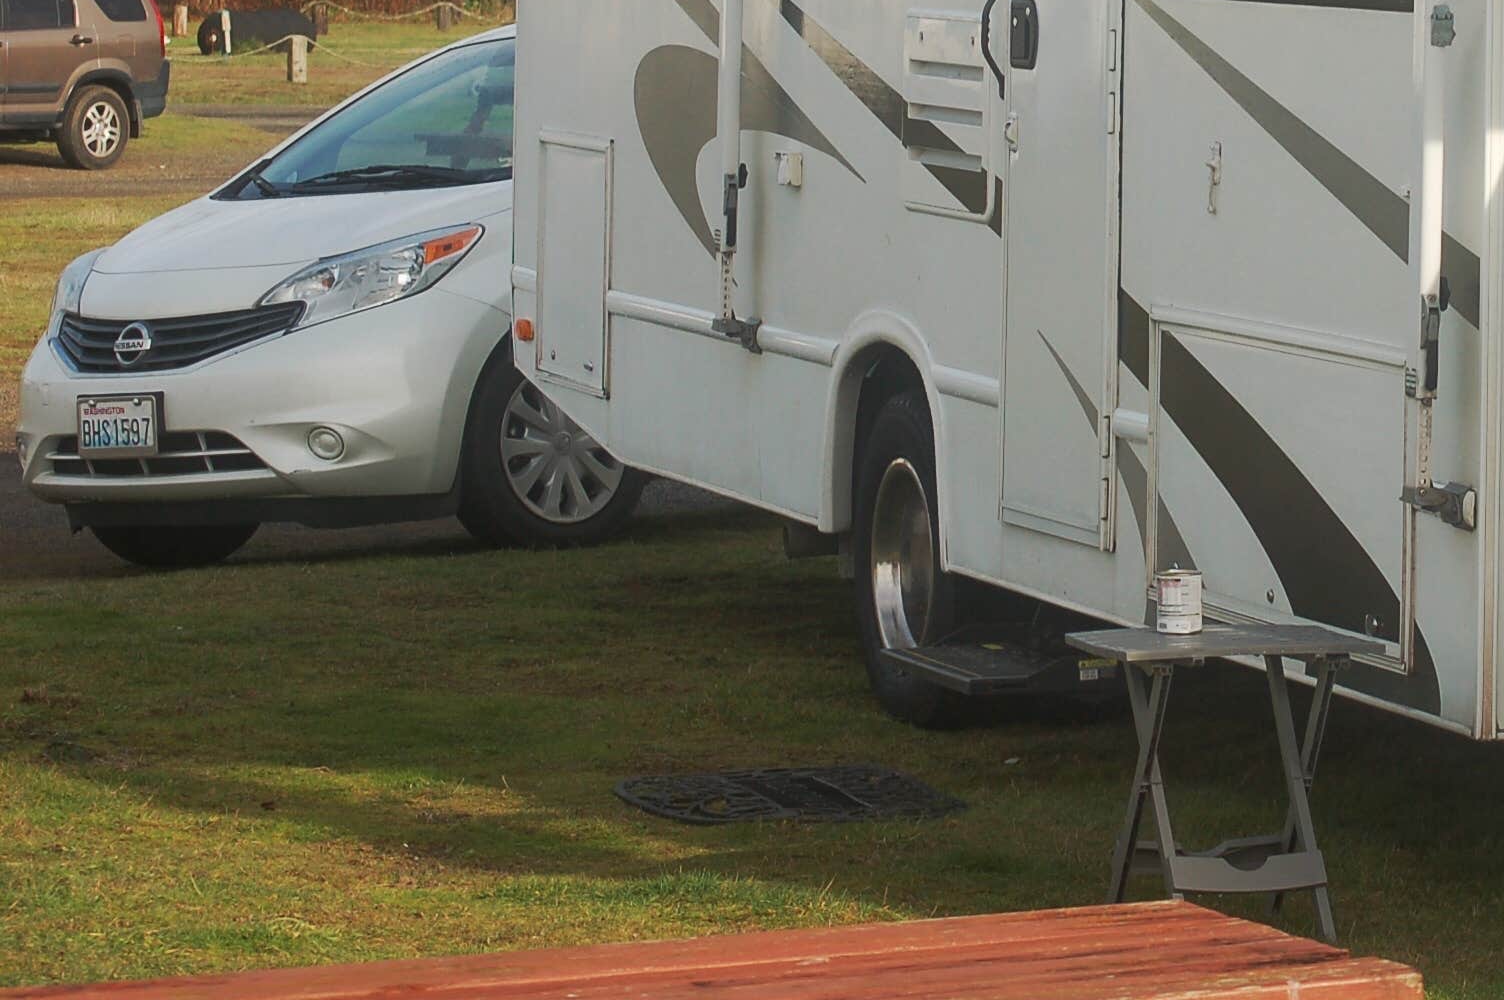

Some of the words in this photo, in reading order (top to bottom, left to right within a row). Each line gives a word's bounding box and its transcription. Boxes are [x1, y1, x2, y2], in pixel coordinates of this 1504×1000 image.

[114, 341, 145, 350] NISSAN
[83, 407, 126, 416] WASHINGTON
[82, 417, 151, 447] BHS1597
